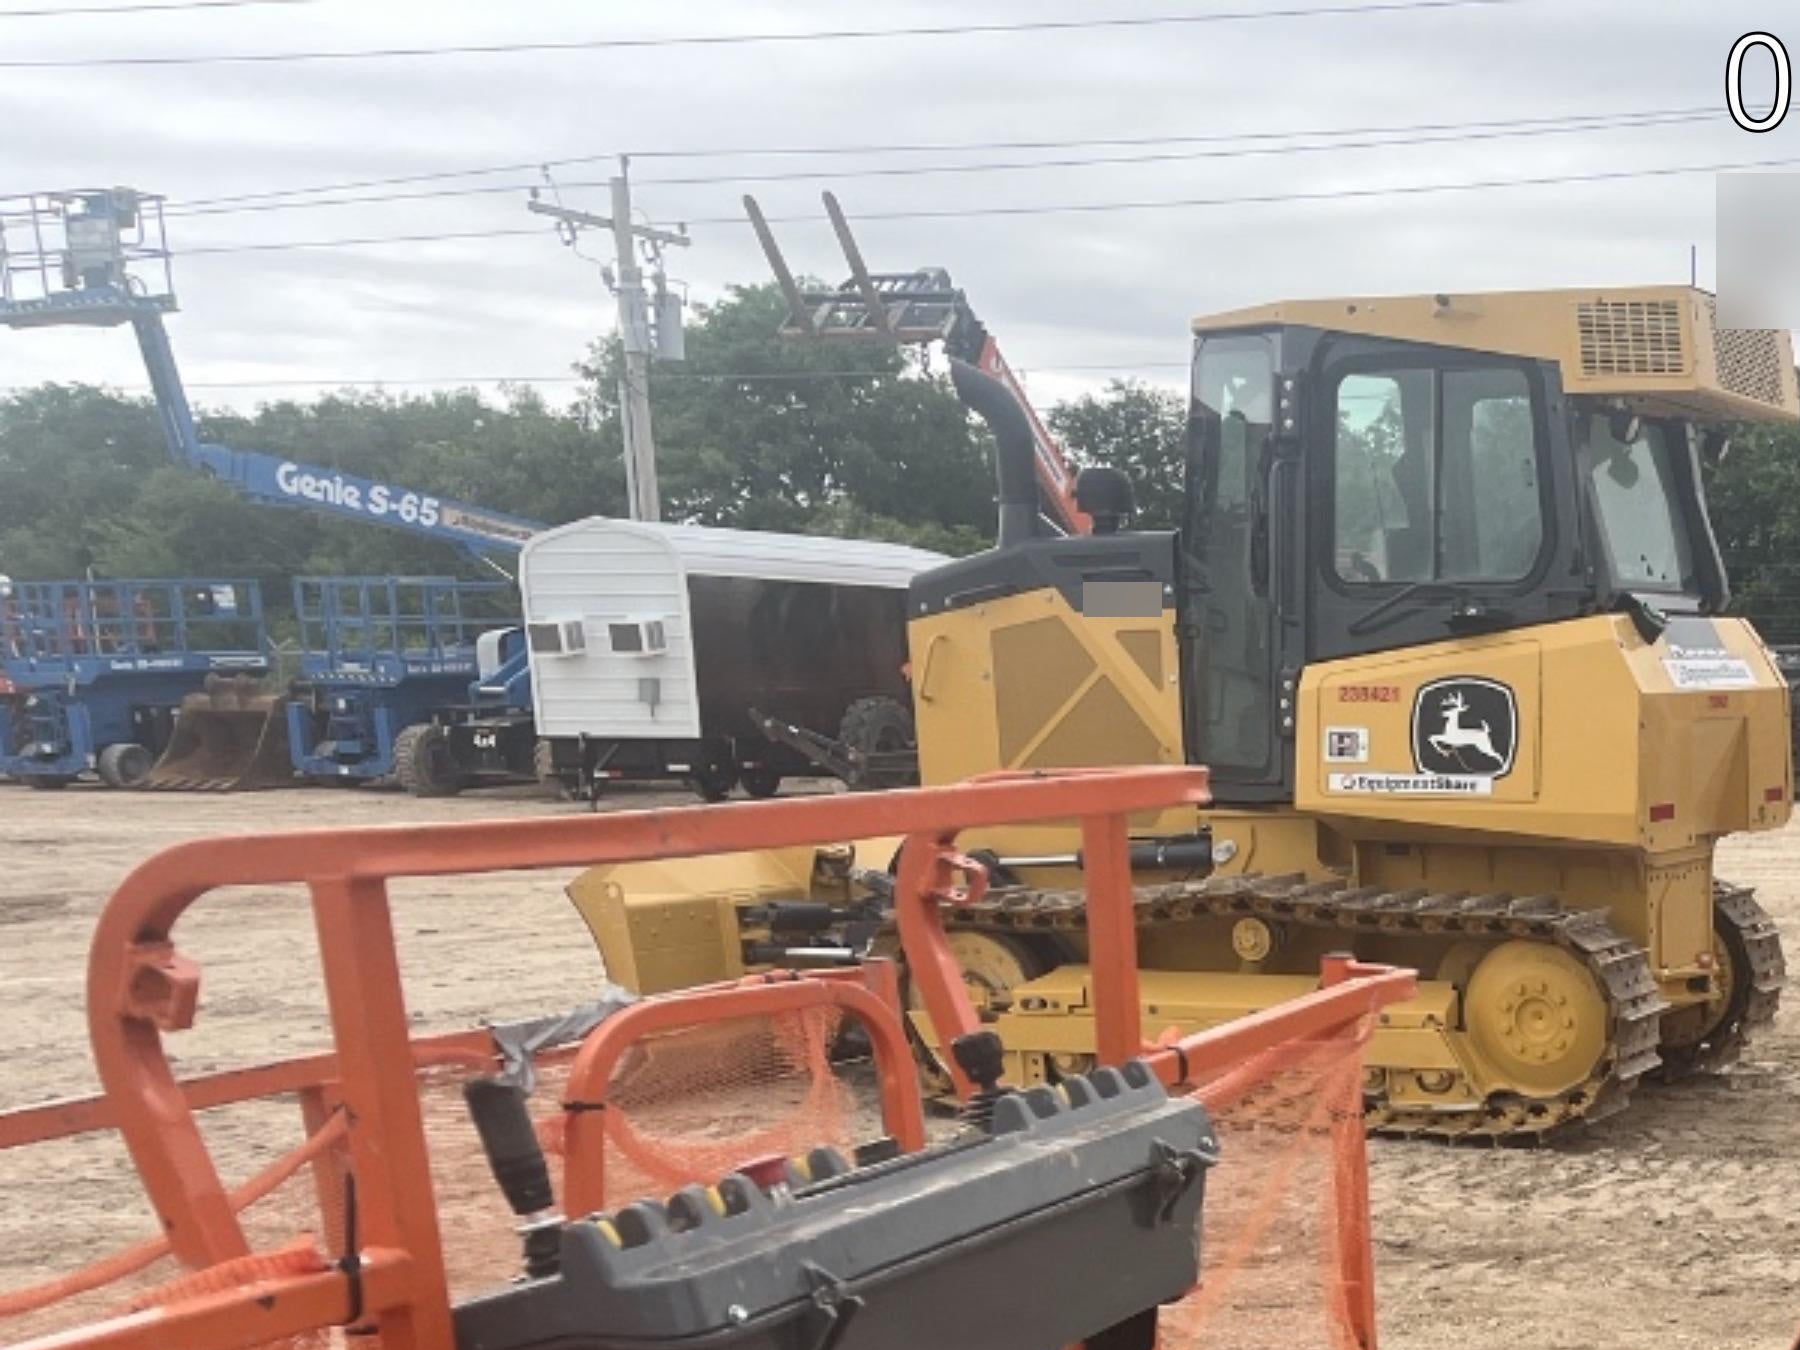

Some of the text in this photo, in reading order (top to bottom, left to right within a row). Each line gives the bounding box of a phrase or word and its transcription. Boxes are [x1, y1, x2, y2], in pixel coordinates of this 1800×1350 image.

[276, 461, 439, 527] Genie S-65
[1358, 776, 1478, 793] EquipmentShare
